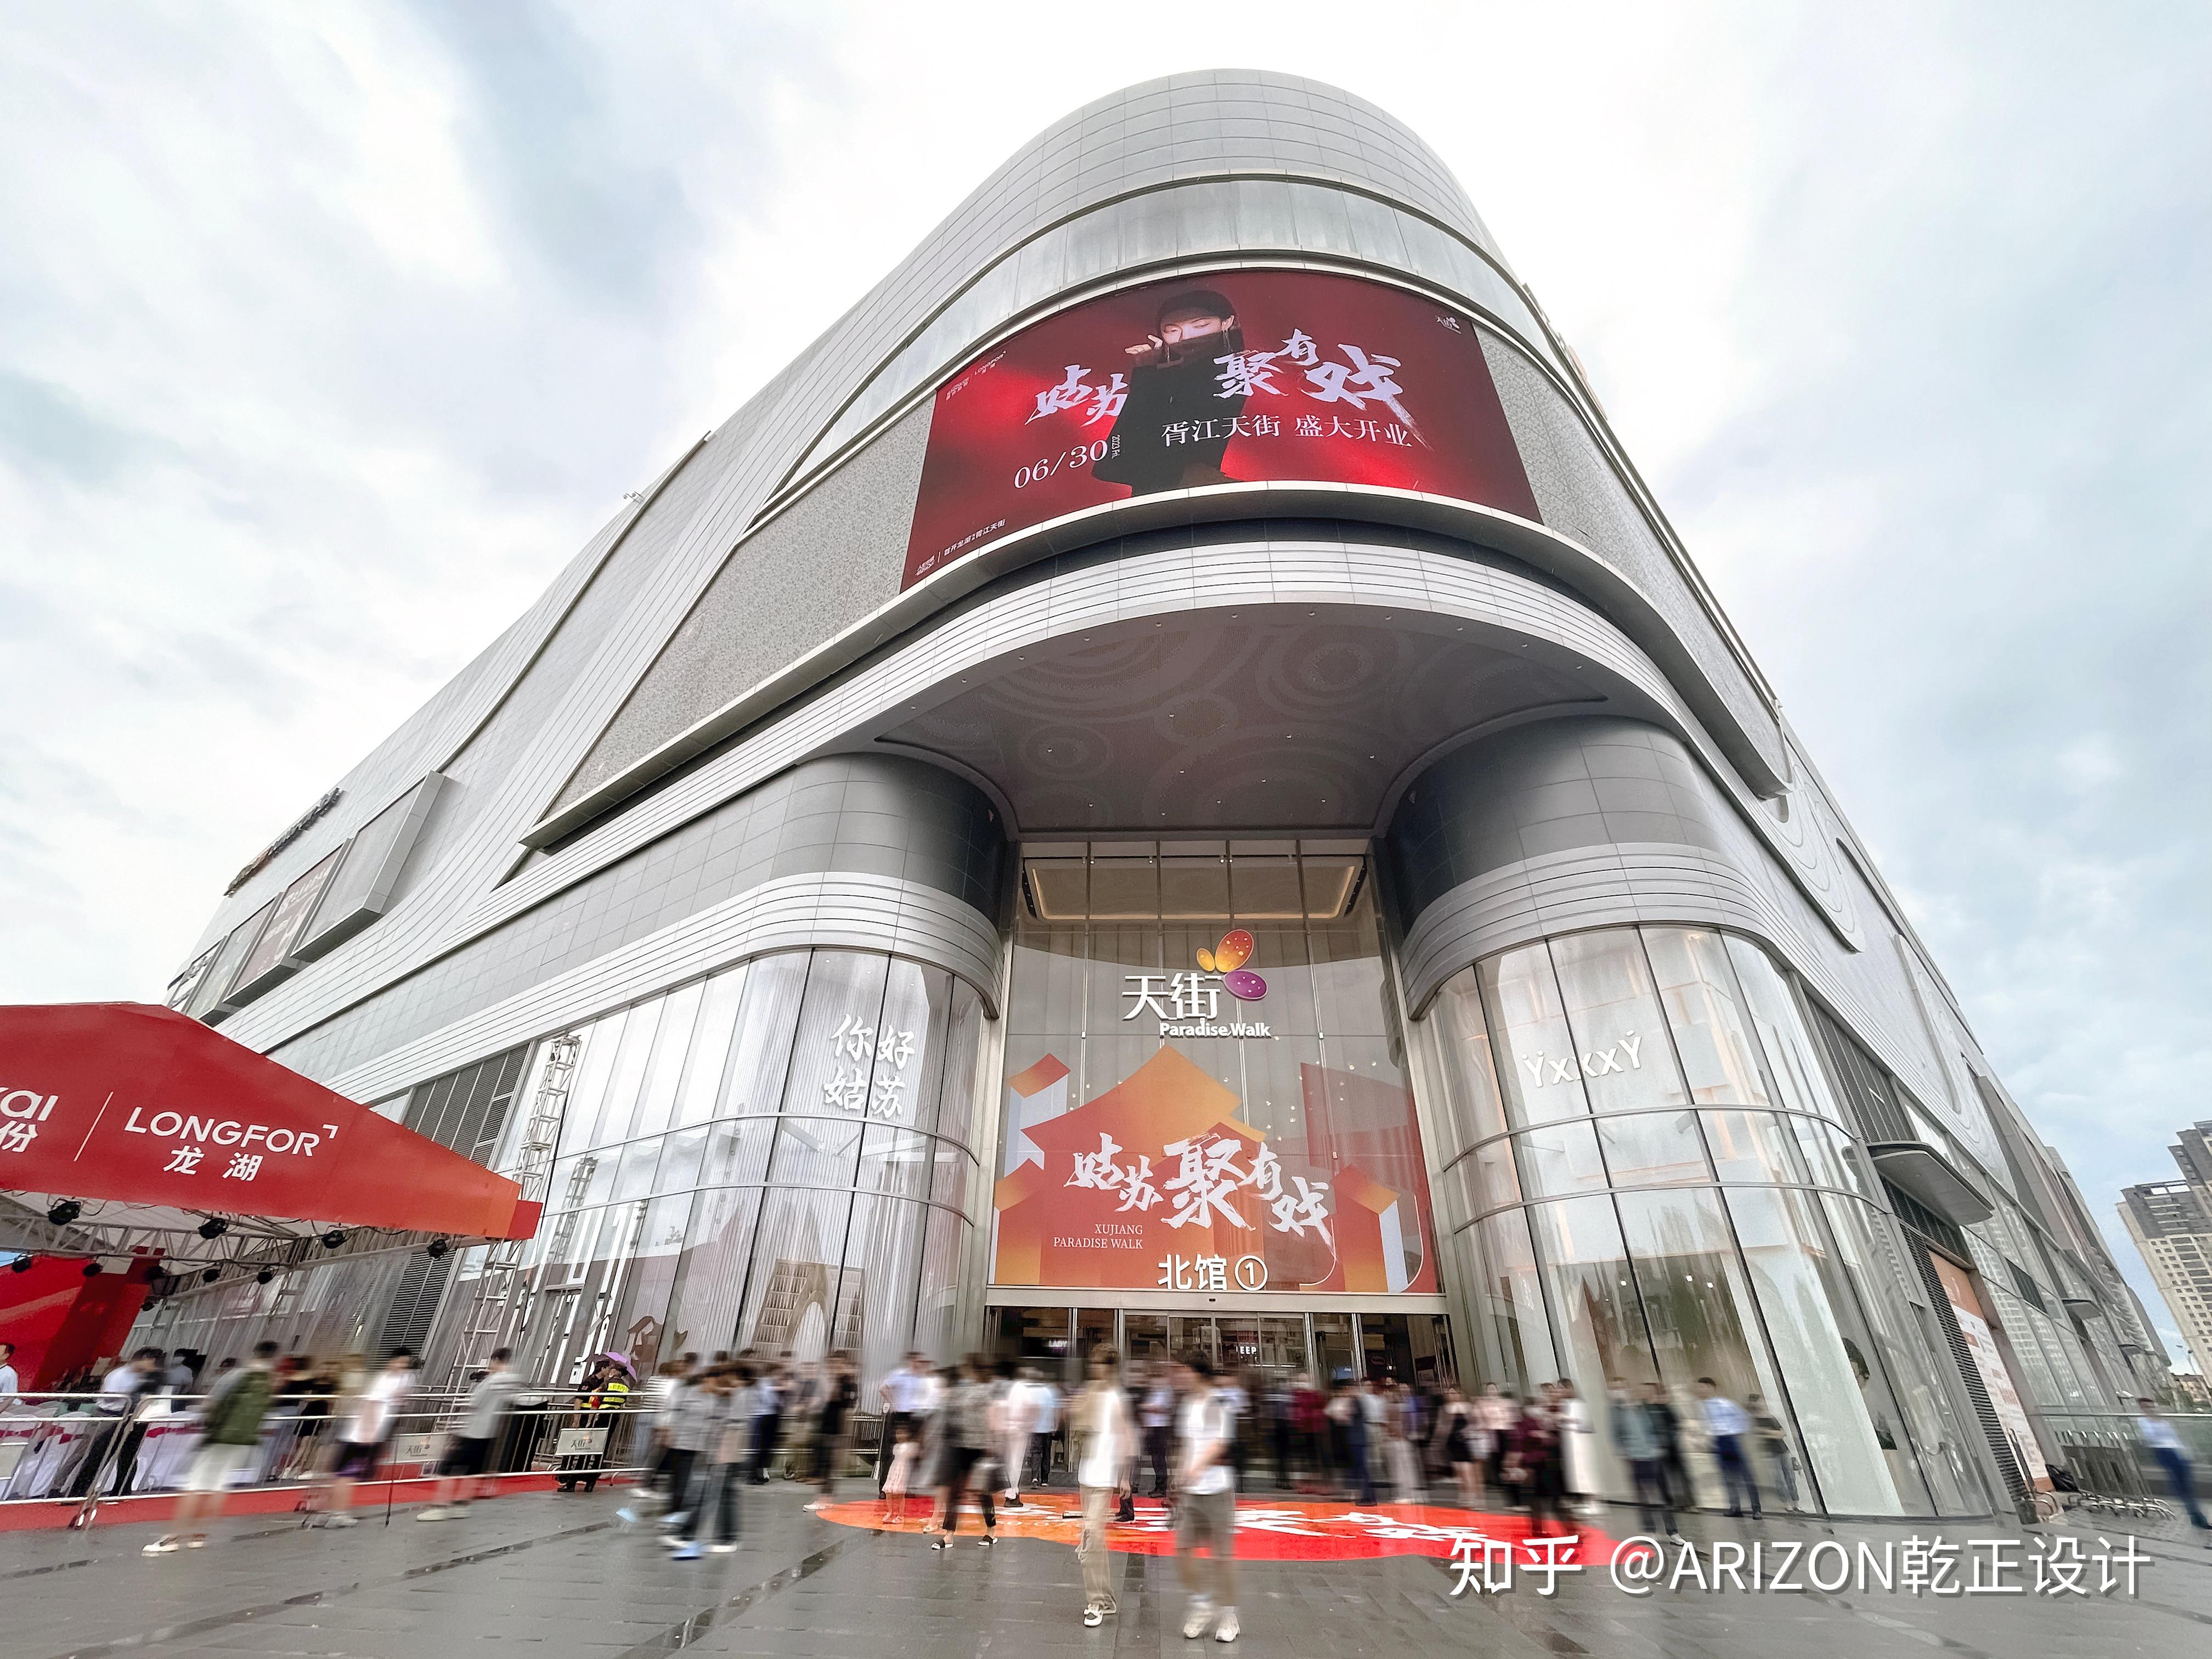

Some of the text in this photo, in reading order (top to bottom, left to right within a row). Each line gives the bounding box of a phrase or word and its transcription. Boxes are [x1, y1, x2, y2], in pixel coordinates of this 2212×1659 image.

[1161, 414, 1412, 448] 胥江天街 盛大开业
[1014, 439, 1108, 488] 06/30
[1122, 972, 1222, 1021] 天街
[830, 1014, 916, 1070] 你好
[1159, 1018, 1272, 1039] Paradise Walk
[823, 1066, 906, 1119] 姑苏
[124, 1106, 320, 1157] LONGFOR
[163, 1145, 264, 1182] 龙湖
[1053, 1237, 1143, 1249] PARADISE WALK
[1094, 1223, 1143, 1235] XUJIANG
[1158, 1254, 1228, 1291] 北馆
